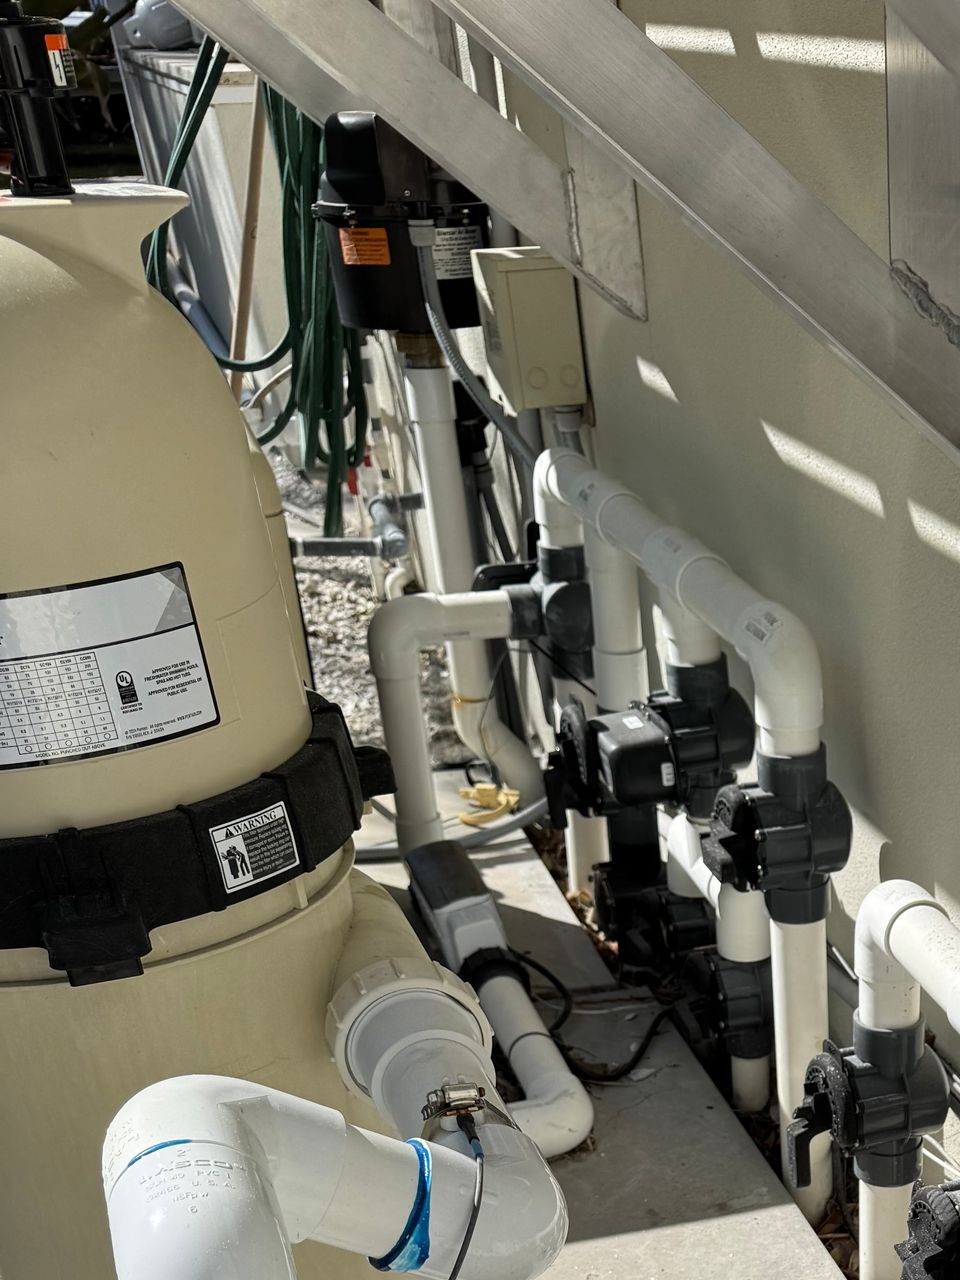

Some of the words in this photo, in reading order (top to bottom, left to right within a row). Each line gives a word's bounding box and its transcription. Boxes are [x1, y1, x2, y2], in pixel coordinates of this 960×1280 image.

[119, 674, 130, 684] UL
[233, 810, 277, 834] WARNING
[197, 1170, 221, 1179] PVC
